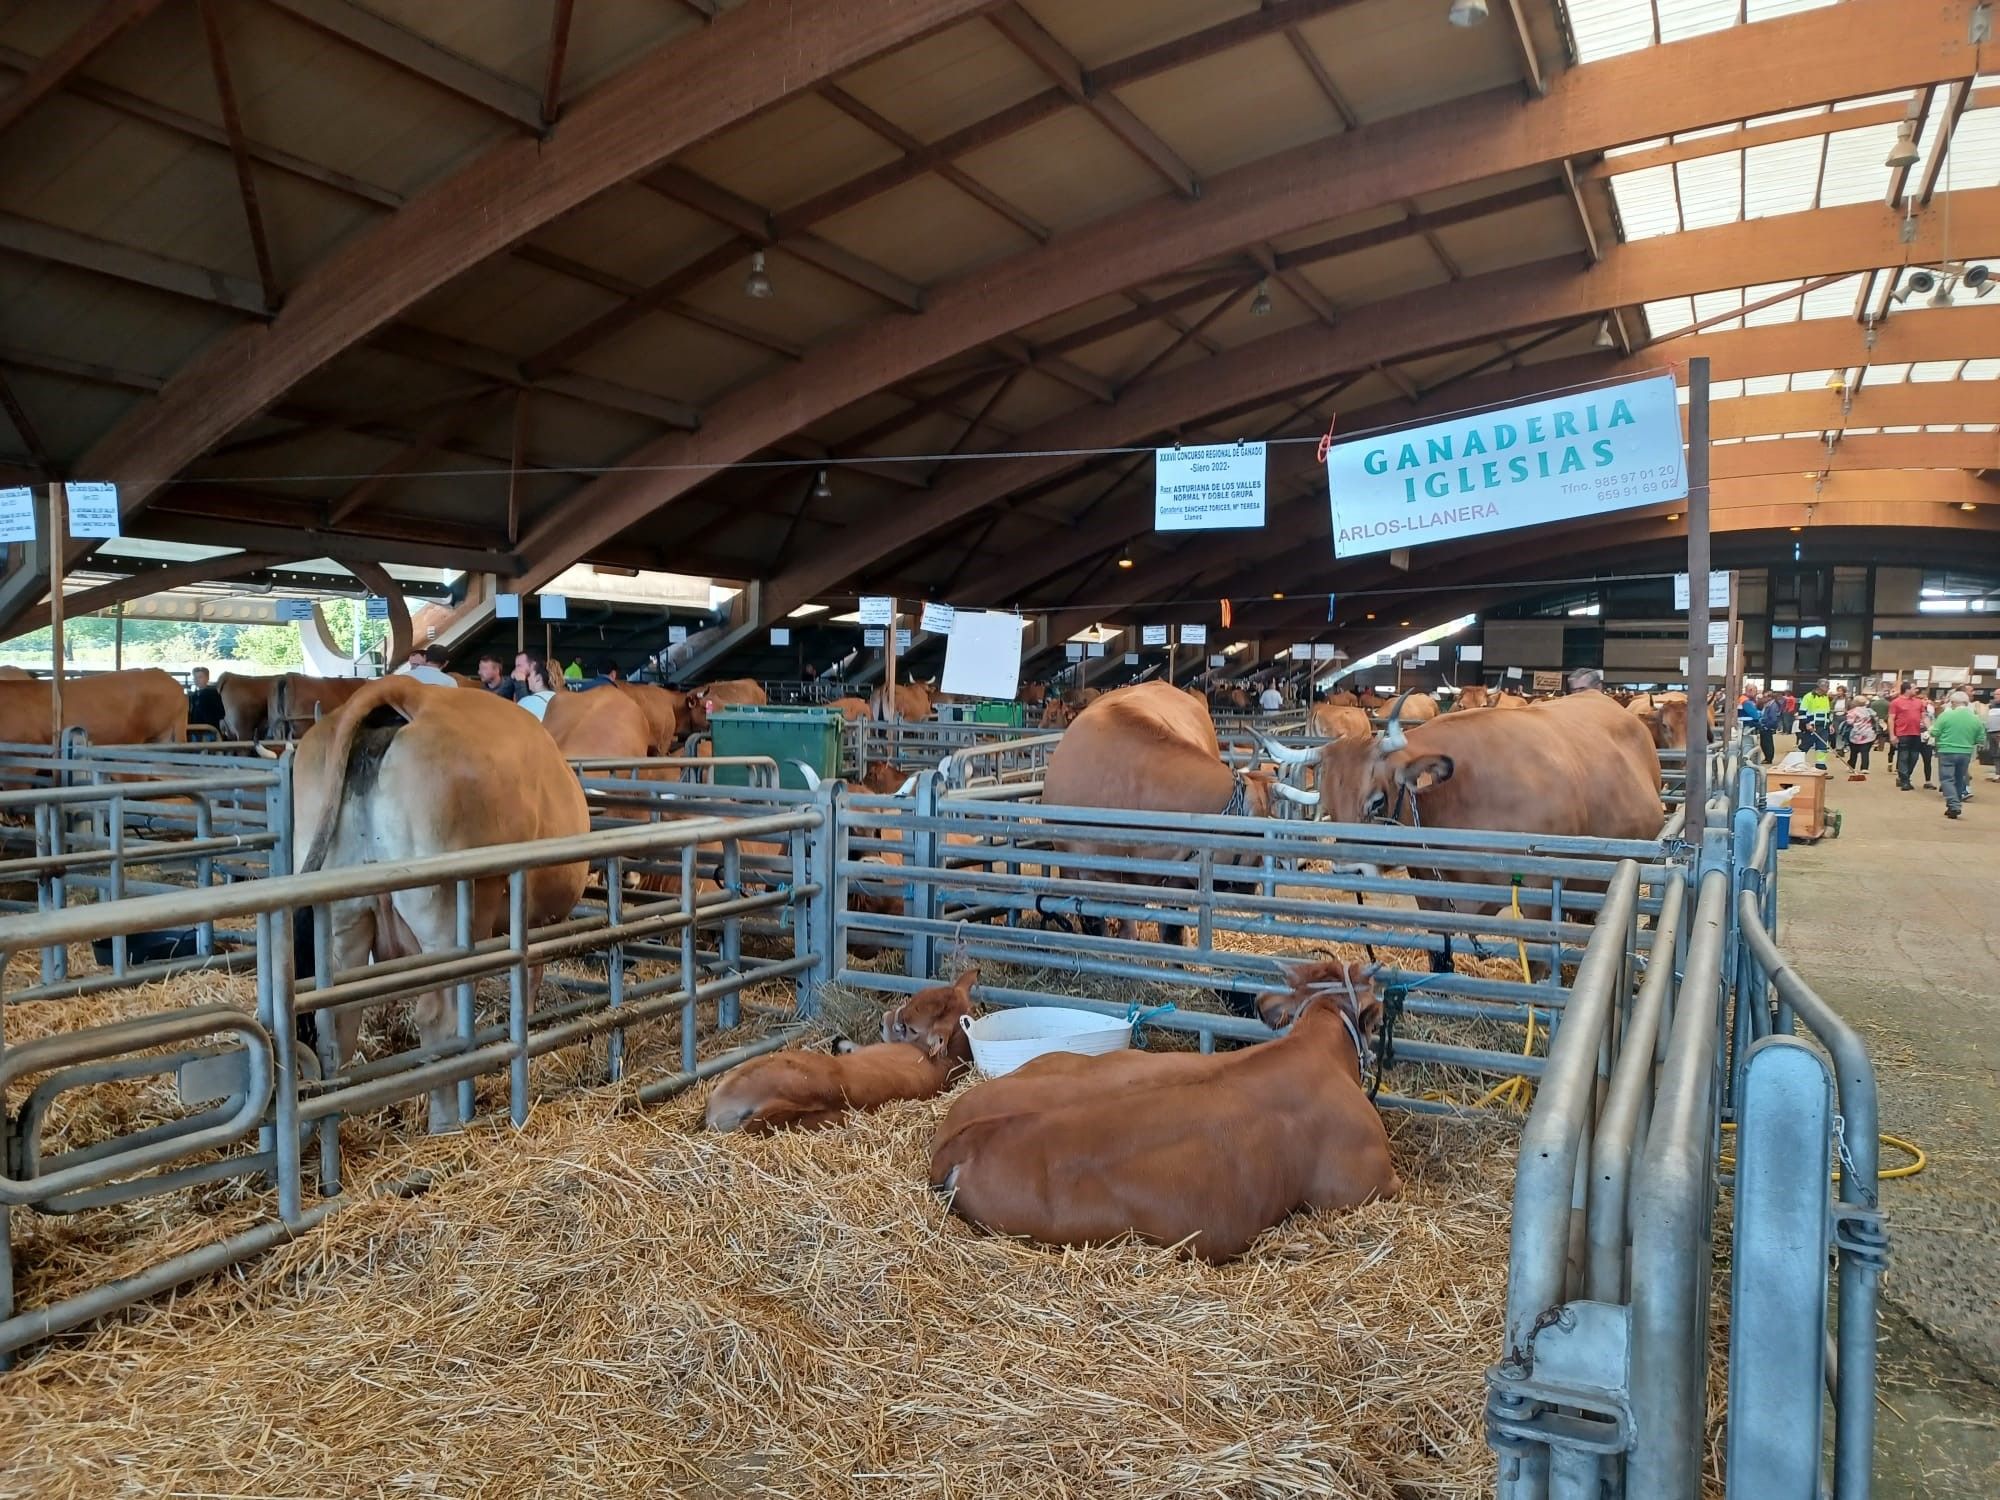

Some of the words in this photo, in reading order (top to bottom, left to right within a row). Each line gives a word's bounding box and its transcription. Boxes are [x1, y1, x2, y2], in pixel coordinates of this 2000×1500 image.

[1363, 398, 1637, 476] GANADERIA
[1178, 450, 1204, 460] CONCURSO
[1206, 449, 1231, 458] REGIONAL
[1232, 448, 1240, 457] DE
[1241, 446, 1262, 456] GANADO
[1404, 439, 1615, 504] IGLESIAS
[1560, 482, 1592, 495] Tfno.
[1595, 475, 1618, 488] 985
[1620, 472, 1636, 484] 97
[1640, 468, 1654, 480] 01
[1659, 465, 1674, 477] 20
[1174, 484, 1210, 493] ASTURIANA
[1212, 483, 1220, 491] DE
[1221, 482, 1234, 490] LOS
[1236, 480, 1261, 489] VALLES
[1174, 493, 1200, 502] NORMAL
[1202, 492, 1206, 500] Y
[1208, 491, 1230, 500] DOBLE
[1231, 490, 1253, 499] GRUPA
[1597, 489, 1620, 502] 659
[1624, 486, 1638, 498] 91
[1642, 482, 1658, 494] 69
[1661, 478, 1678, 490] 02
[1338, 502, 1499, 542] ARLOS-LLANERA
